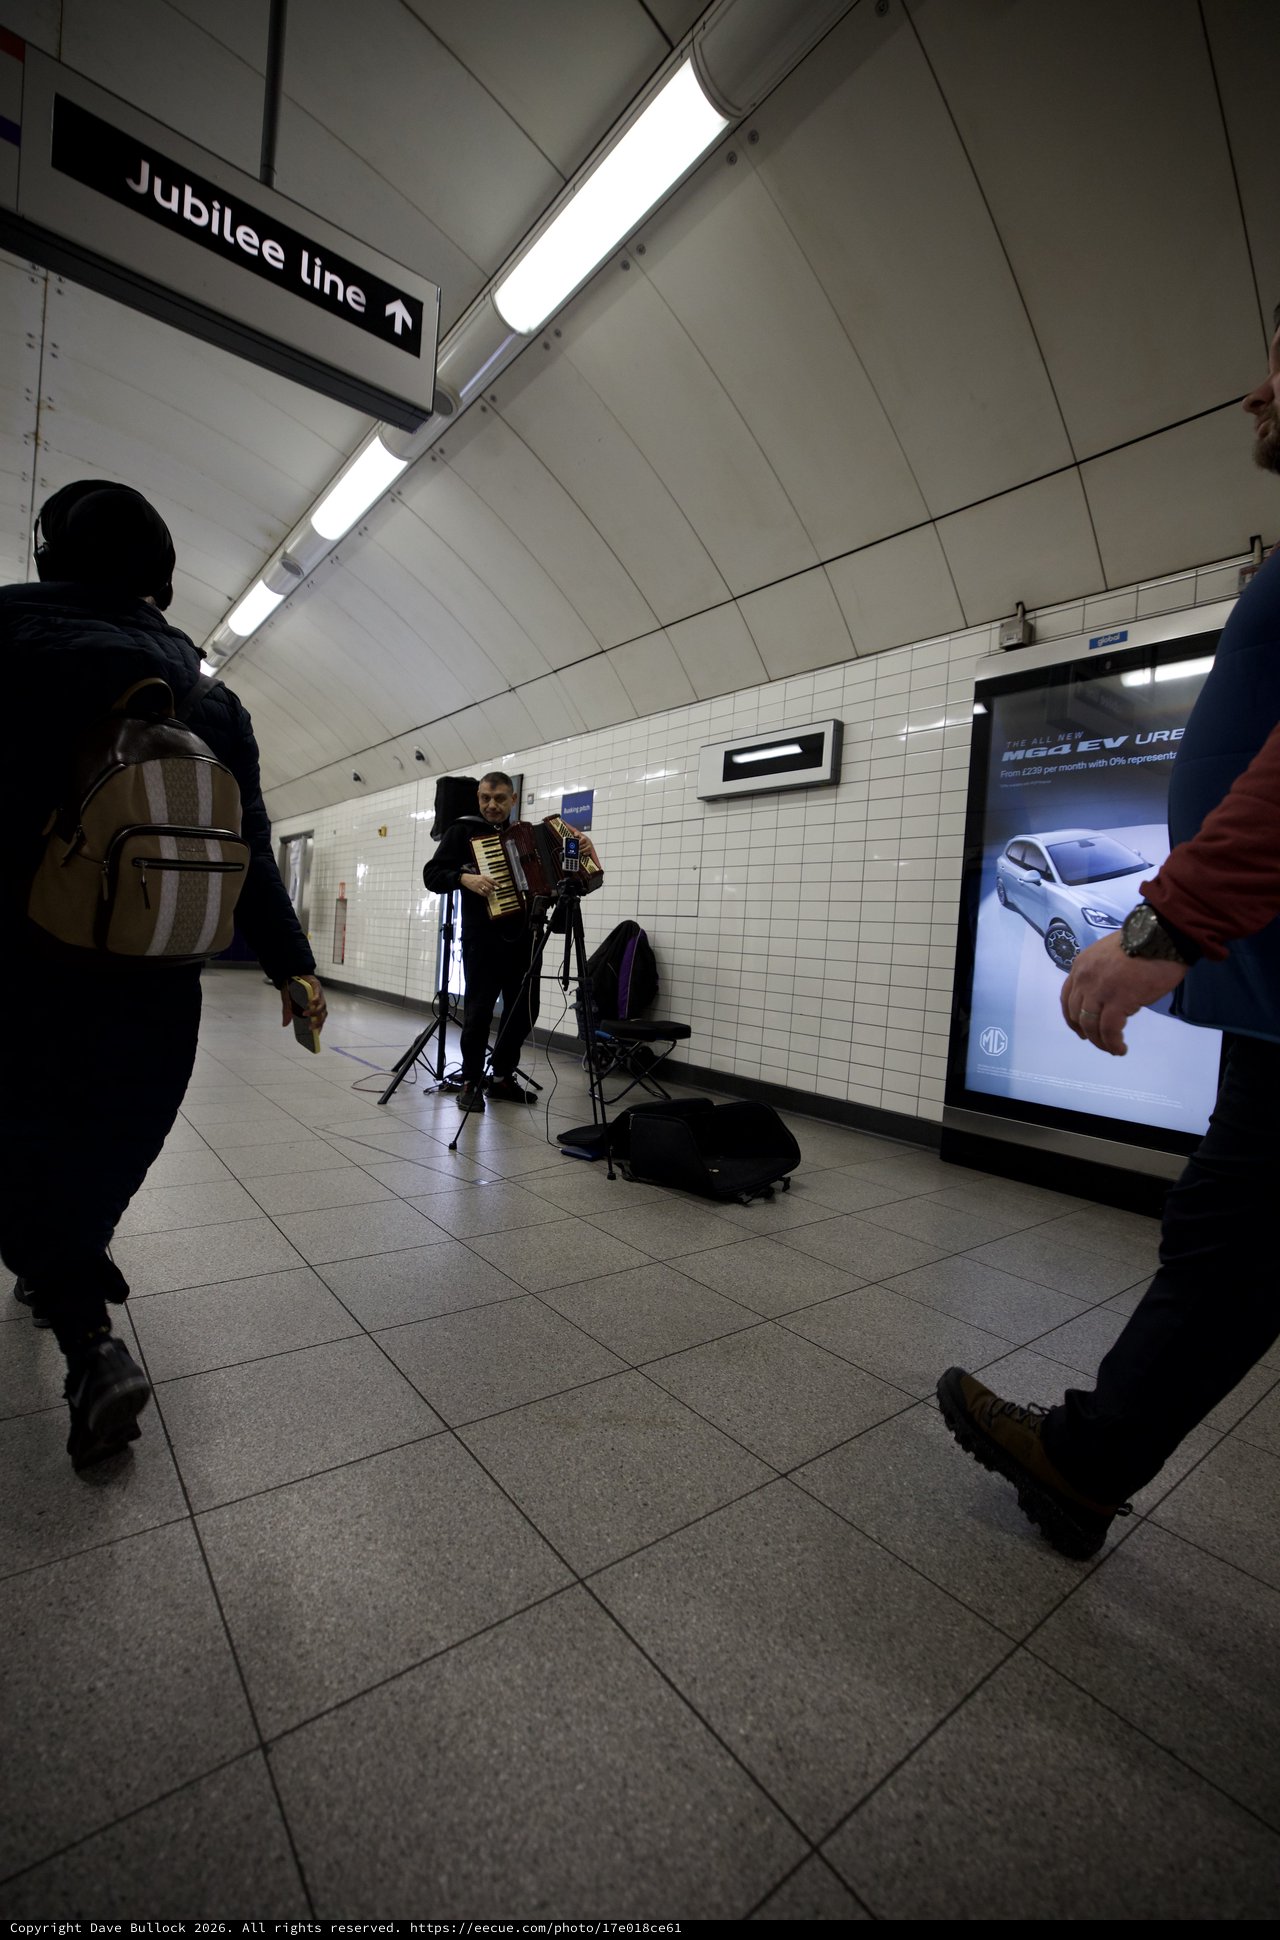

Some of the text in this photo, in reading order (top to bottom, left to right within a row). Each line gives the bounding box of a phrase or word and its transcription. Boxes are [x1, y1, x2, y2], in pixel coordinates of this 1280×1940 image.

[125, 158, 367, 314] Jubilee line
[1097, 632, 1121, 647] global
[1001, 743, 1072, 762] MG4
[1076, 735, 1130, 753] EV
[1007, 730, 1084, 748] THE ALL NEW
[1000, 769, 1021, 778] From
[1022, 766, 1042, 776] £239
[1043, 766, 1057, 776] per
[1058, 760, 1087, 772] month
[1088, 759, 1108, 769] with
[1109, 756, 1126, 767] 0%
[981, 1028, 1007, 1055] MG
